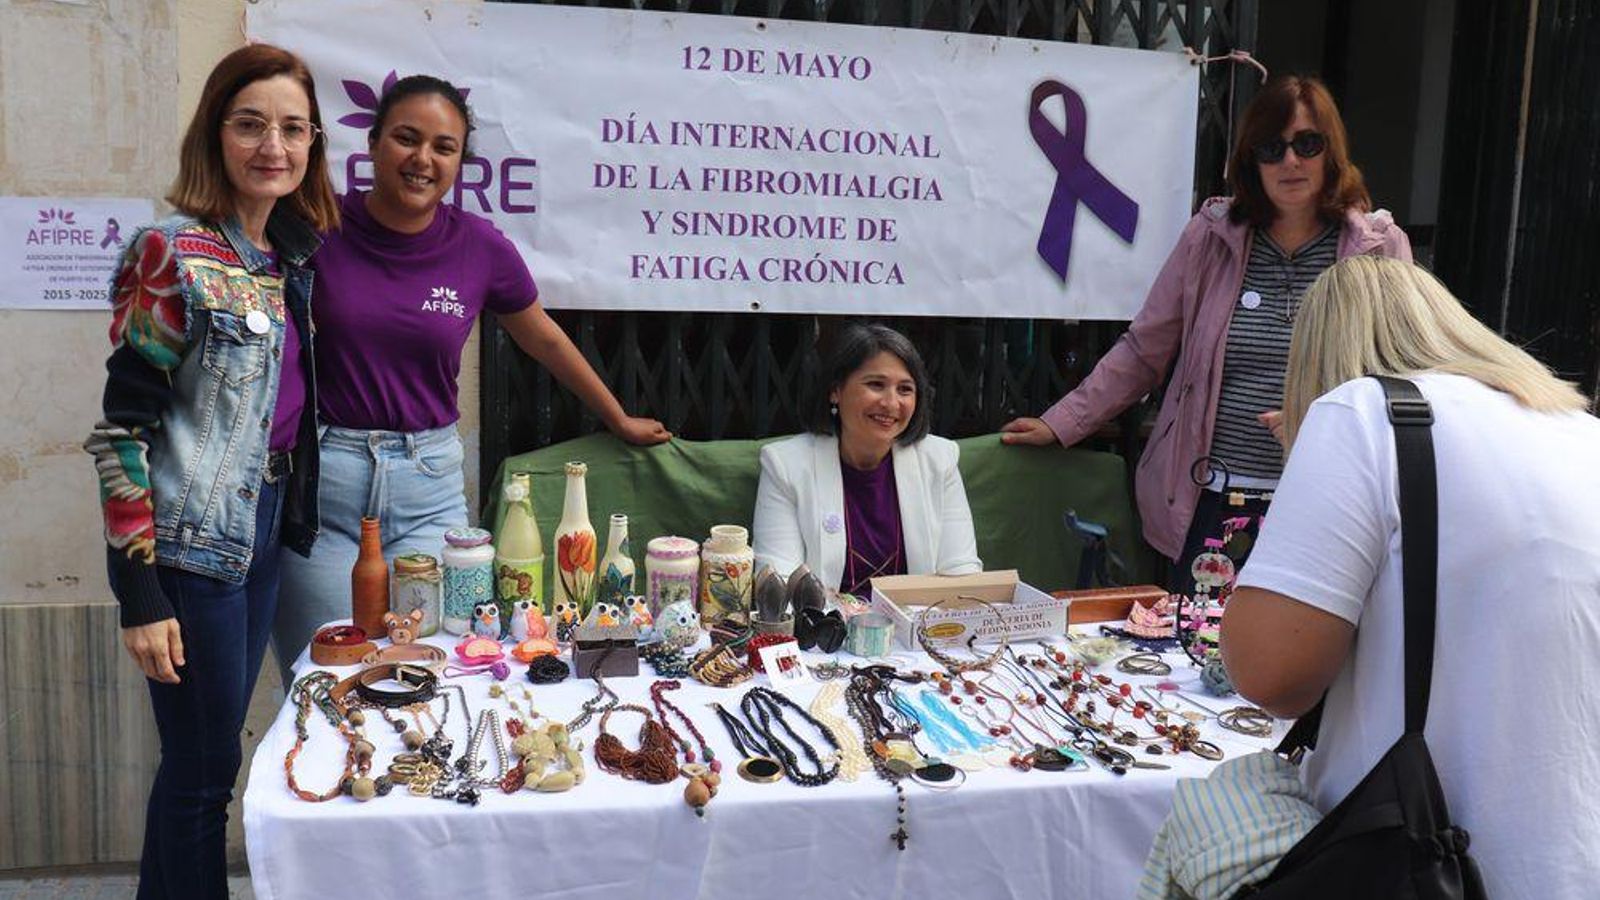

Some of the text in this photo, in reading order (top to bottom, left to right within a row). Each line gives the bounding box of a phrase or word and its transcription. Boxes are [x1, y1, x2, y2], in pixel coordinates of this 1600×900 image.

[683, 46, 872, 81] 12 DE MAYO
[602, 112, 940, 159] DÍA INTERNACIONAL
[594, 163, 943, 202] DE LA FIBROMIALGIA
[26, 229, 95, 246] AFIPRE
[641, 210, 898, 243] Y SINDROME DE
[631, 252, 905, 285] FATIGA CRÓNICA
[43, 289, 72, 300] 2015
